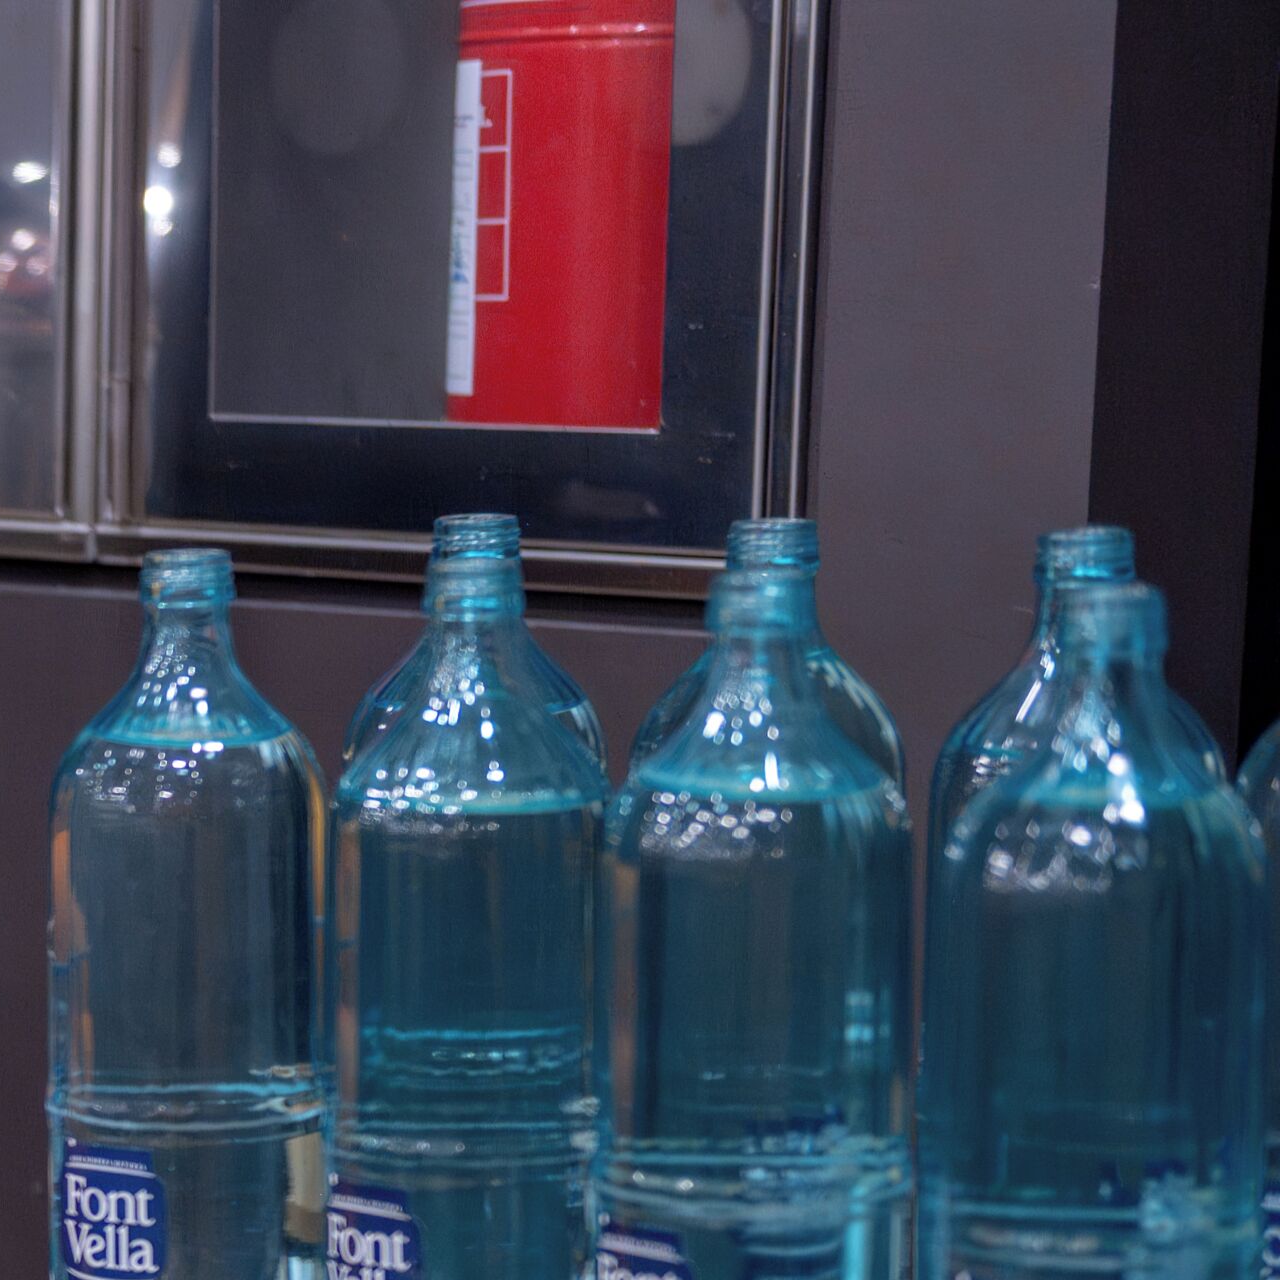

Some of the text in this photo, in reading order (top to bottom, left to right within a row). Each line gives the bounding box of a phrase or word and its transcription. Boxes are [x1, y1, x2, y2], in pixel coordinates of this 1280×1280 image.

[65, 1173, 157, 1228] Font
[64, 1219, 160, 1273] Vella
[327, 1212, 412, 1273] Font
